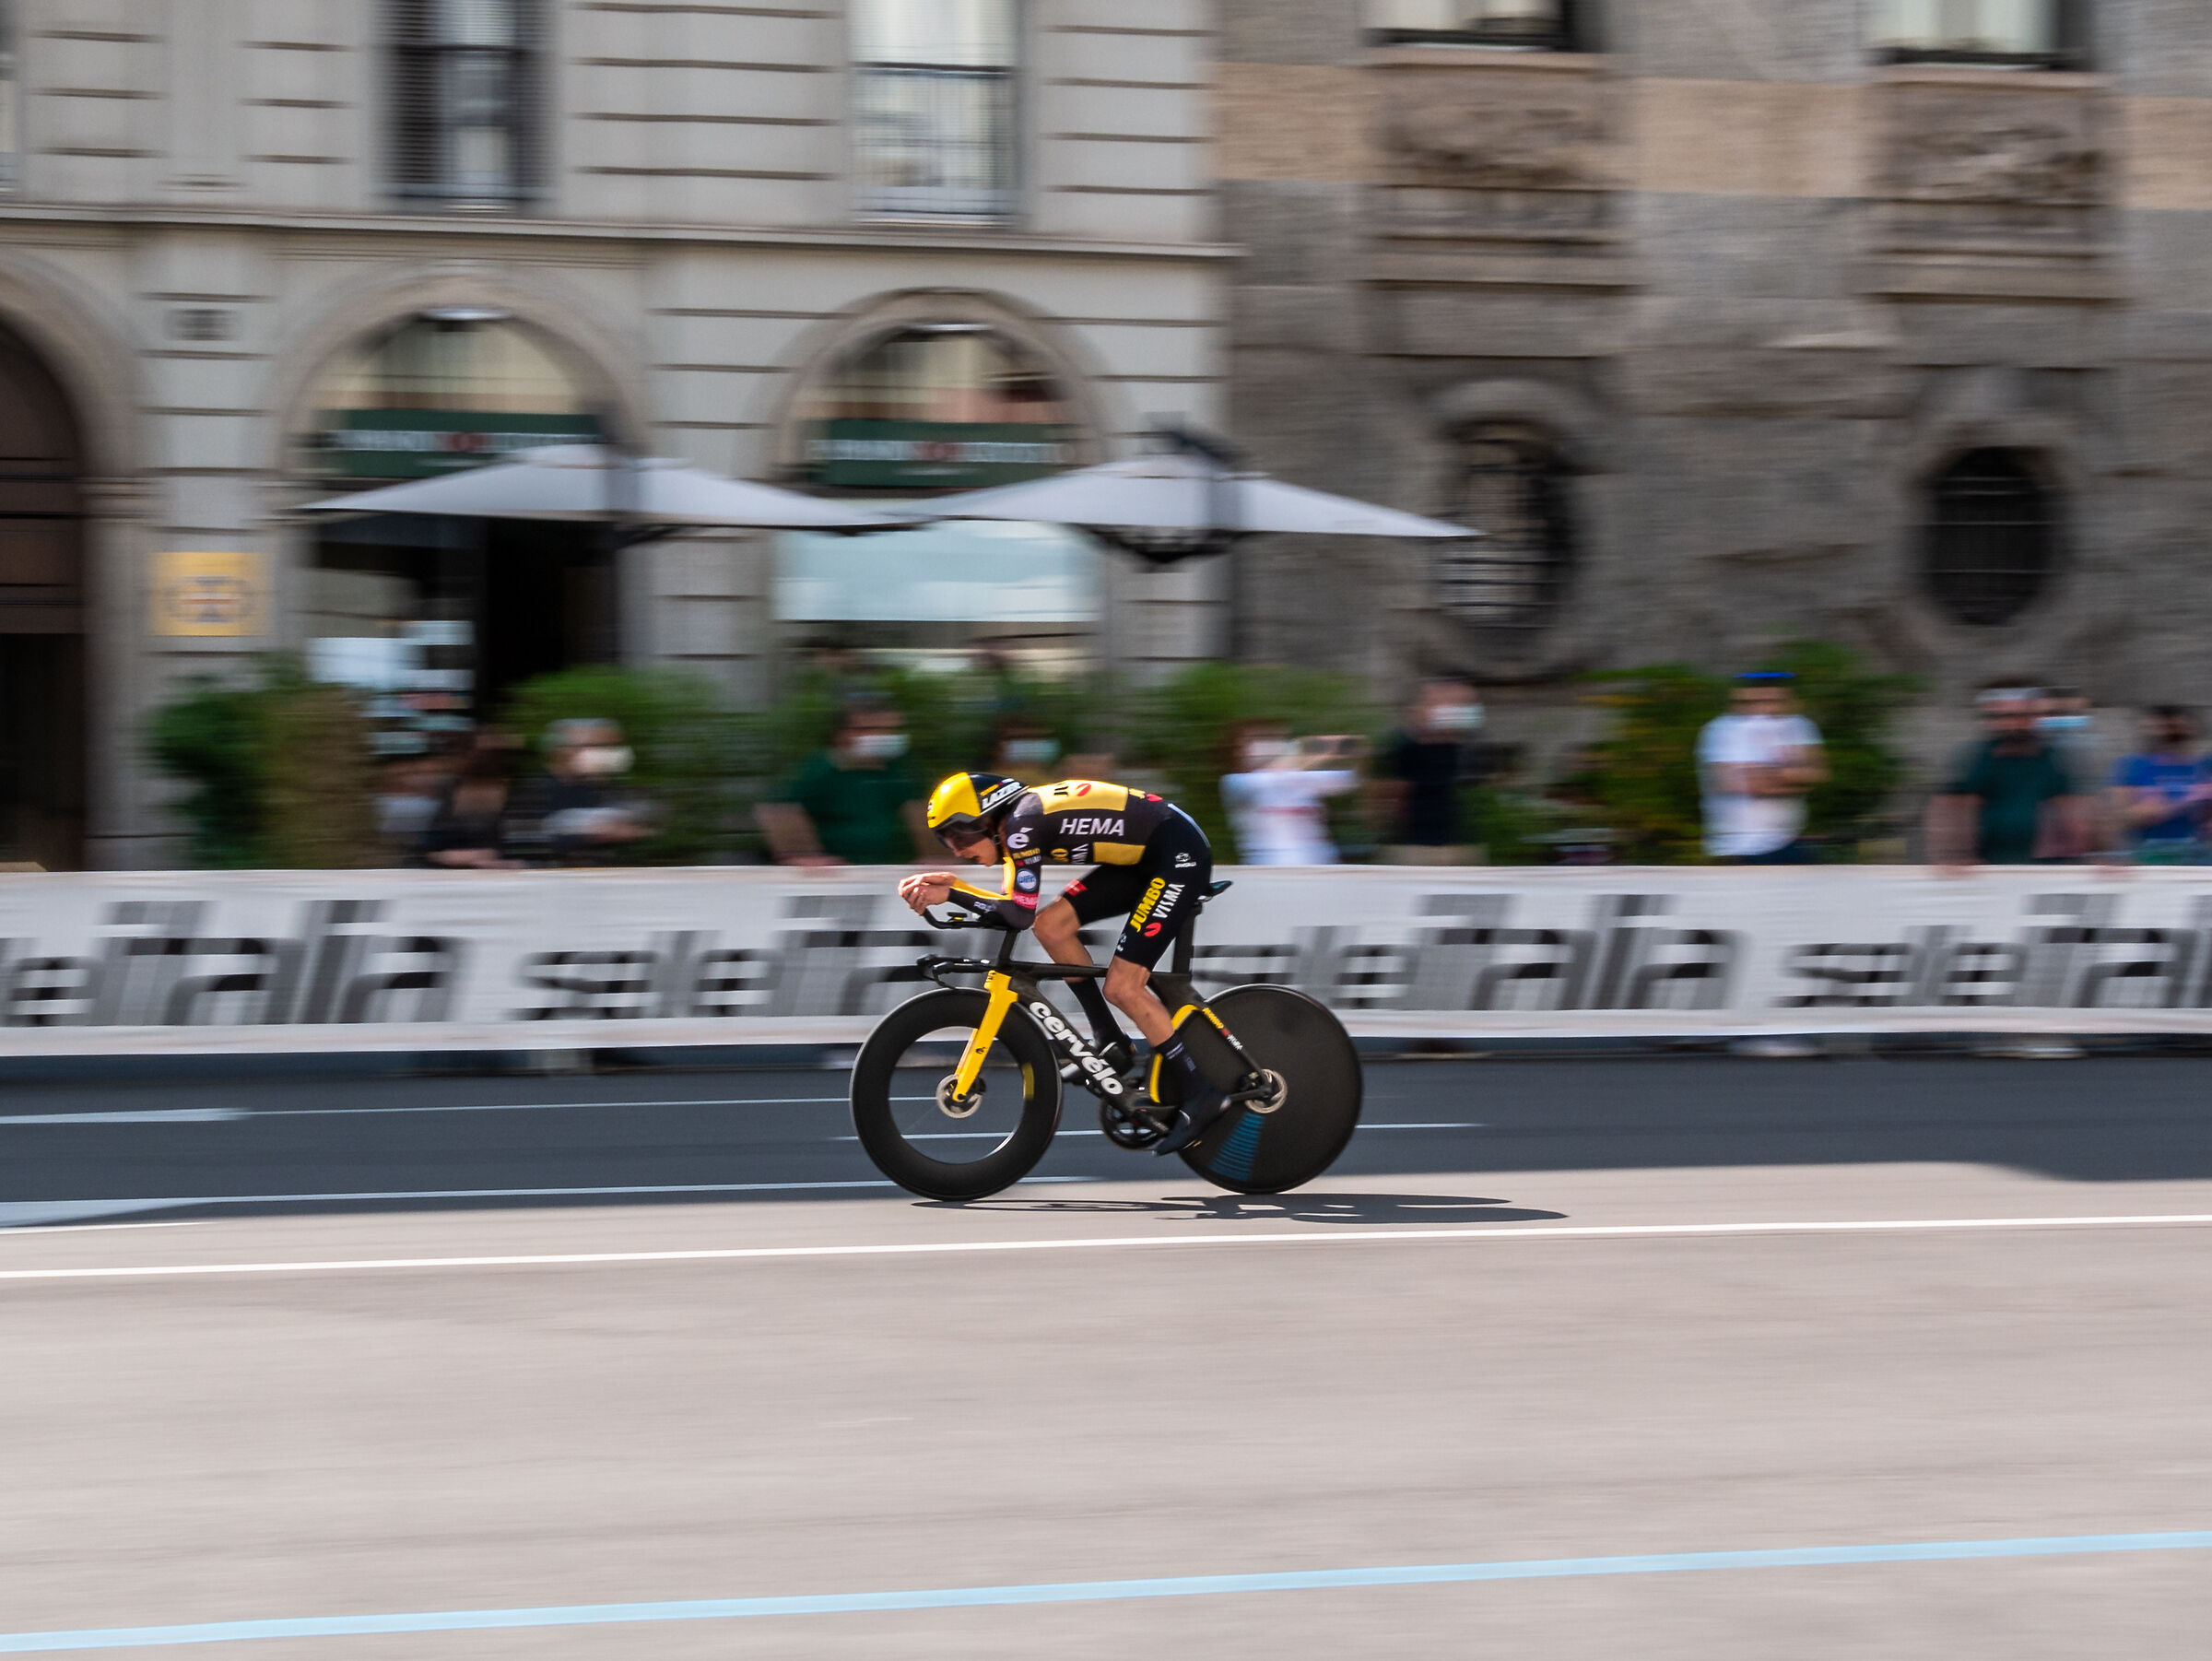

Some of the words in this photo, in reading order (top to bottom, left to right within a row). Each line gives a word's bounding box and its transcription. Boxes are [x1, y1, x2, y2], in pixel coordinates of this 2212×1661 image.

[1059, 818, 1124, 836] HEMA
[1130, 878, 1166, 932] JUMBO
[1152, 883, 1185, 918] VISMA
